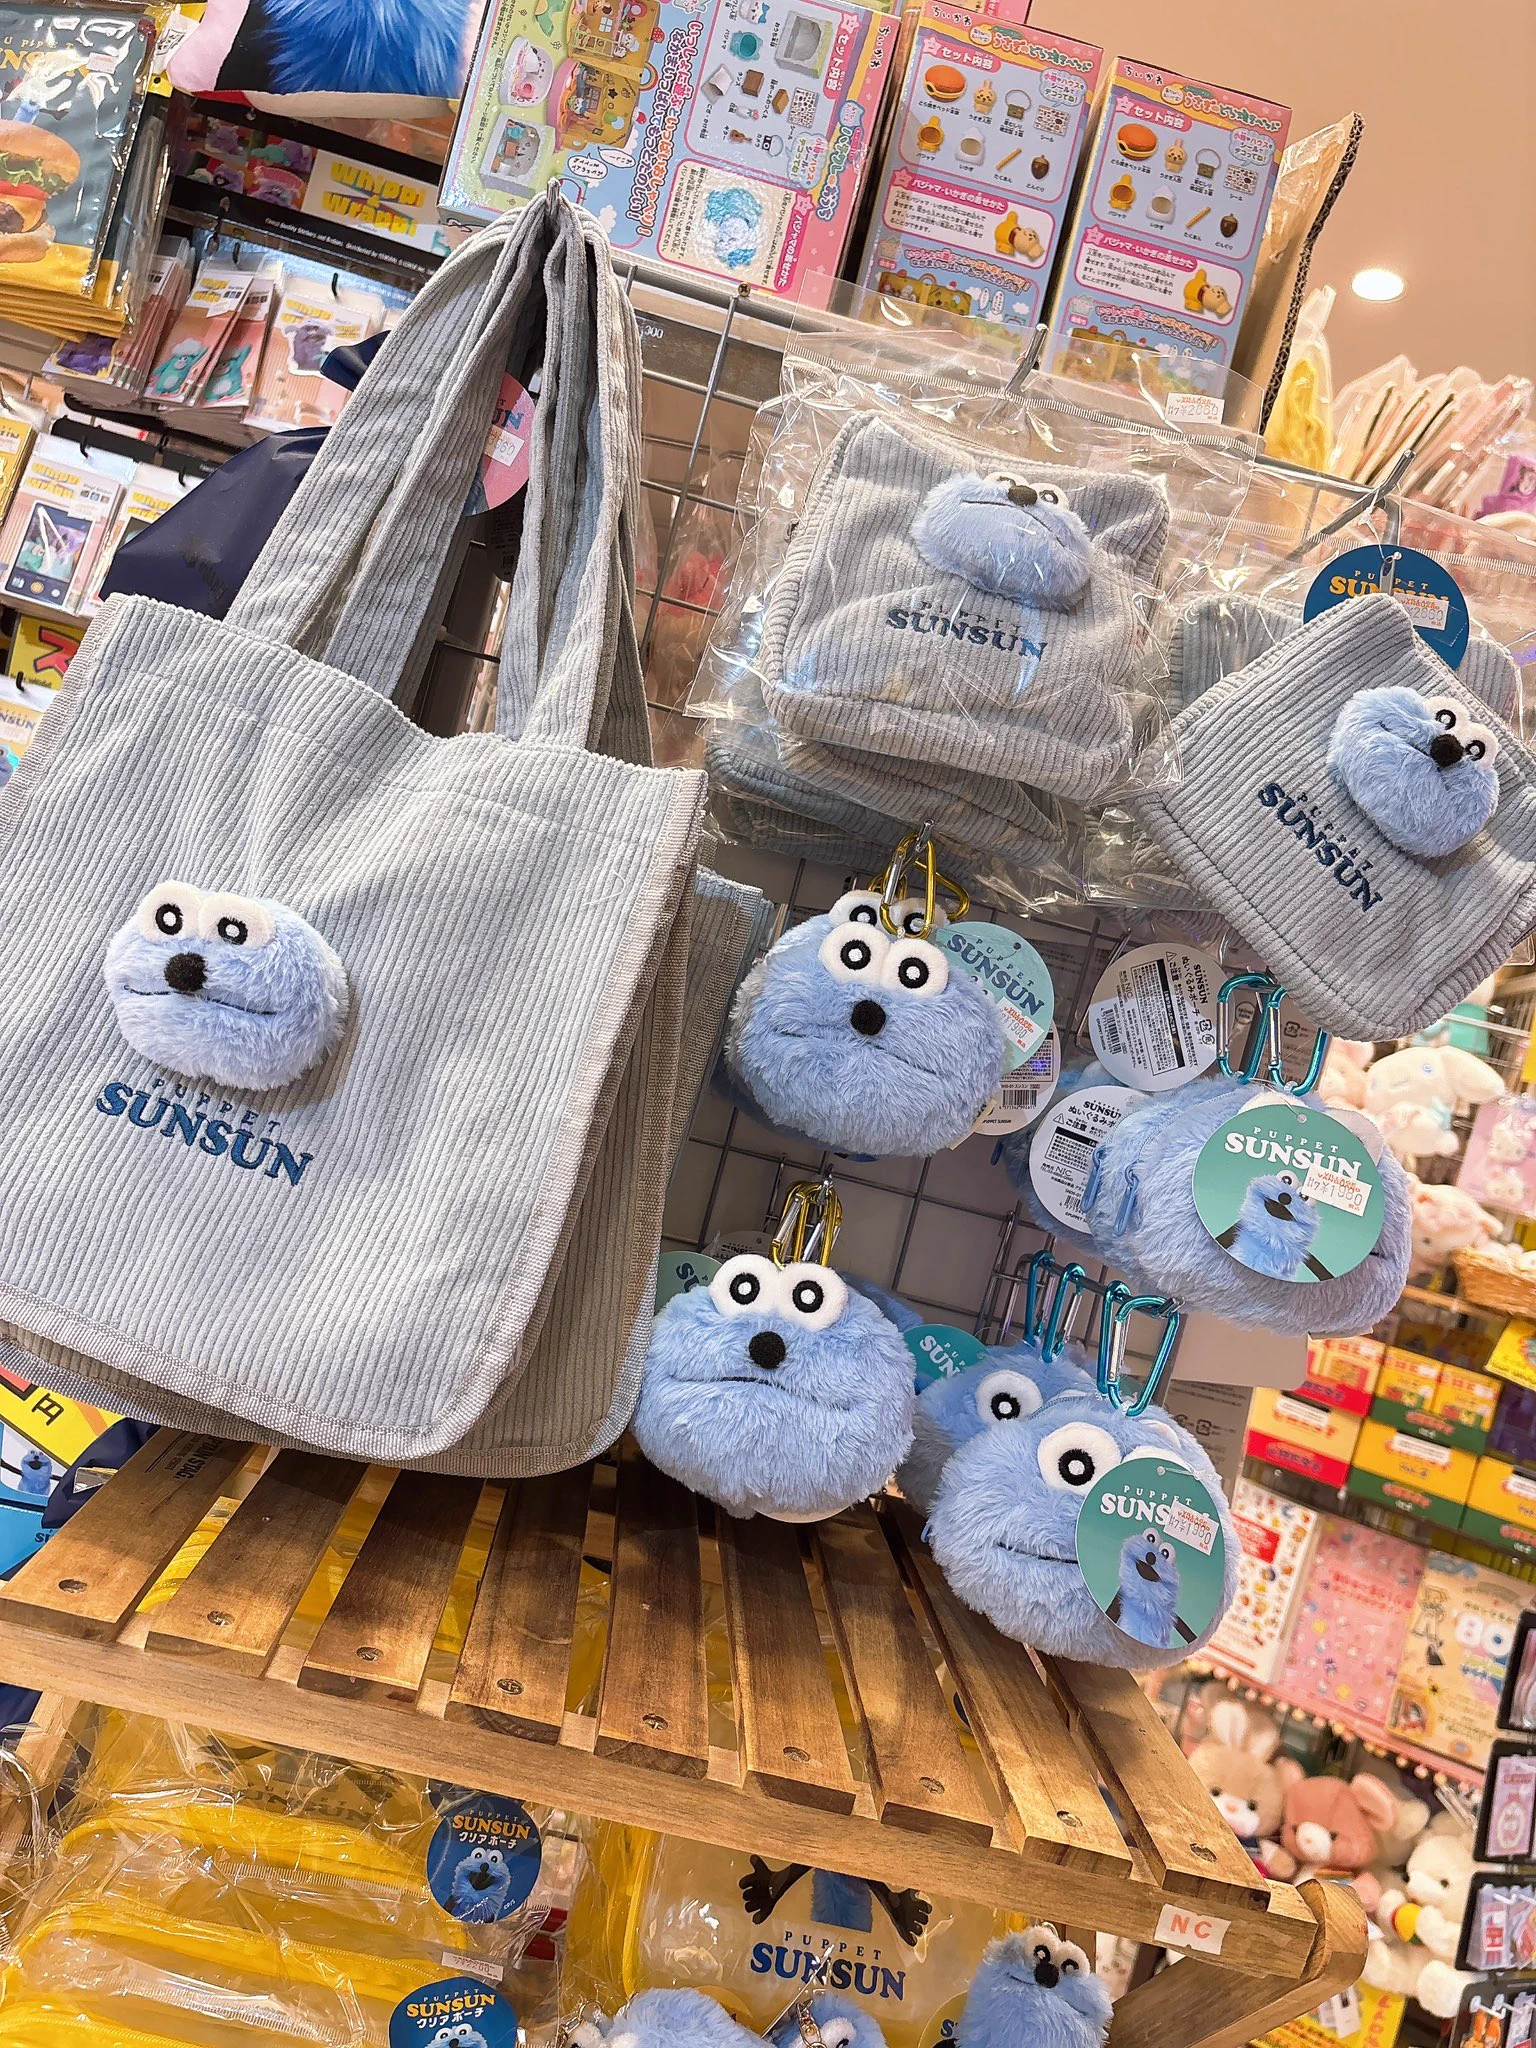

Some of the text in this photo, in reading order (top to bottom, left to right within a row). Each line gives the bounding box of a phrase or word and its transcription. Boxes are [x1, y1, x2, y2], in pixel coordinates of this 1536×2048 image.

[931, 6, 973, 27] ちいかわ
[868, 23, 892, 71] ちいかわ
[940, 46, 994, 71] セット内容
[824, 33, 853, 92] セット内容
[1124, 65, 1165, 85] ちいかわ
[626, 29, 686, 220] なかまいっぱいでもっとたのしい!
[1132, 105, 1185, 130] セット内容
[775, 214, 806, 289] パジャマの着せかた
[1354, 569, 1430, 589] PUPET
[886, 608, 1048, 662] SUNSUN
[1257, 783, 1384, 912] SUNSUN
[947, 933, 1045, 1016] SUNSUN
[976, 938, 1035, 986] PUPPET
[1168, 961, 1181, 982] ご注意
[1178, 956, 1204, 1017] ぬいぐるみポーチ
[1191, 964, 1210, 1004] SUNSUN
[152, 1078, 281, 1133] PUPPET
[1067, 1106, 1117, 1128] ぬいぐるみポ
[96, 1081, 314, 1186] SUNSUN
[1065, 1119, 1088, 1132] ご注意
[1253, 1126, 1339, 1154] PUPPET
[1225, 1132, 1362, 1181] SUNSUN
[1319, 1178, 1364, 1207] ¥1980
[1100, 1492, 1178, 1526] SUNS
[1123, 1485, 1192, 1506] PUPPET
[453, 1815, 530, 1840] SUNSUN
[459, 1831, 517, 1849] クリアポーチ
[1170, 1913, 1213, 1940] NC
[784, 1931, 883, 1960] PUPPET
[750, 1942, 906, 2001] SUNSUN
[406, 1993, 496, 2018] SUNSUN
[416, 2008, 485, 2029] クリアポーチ
